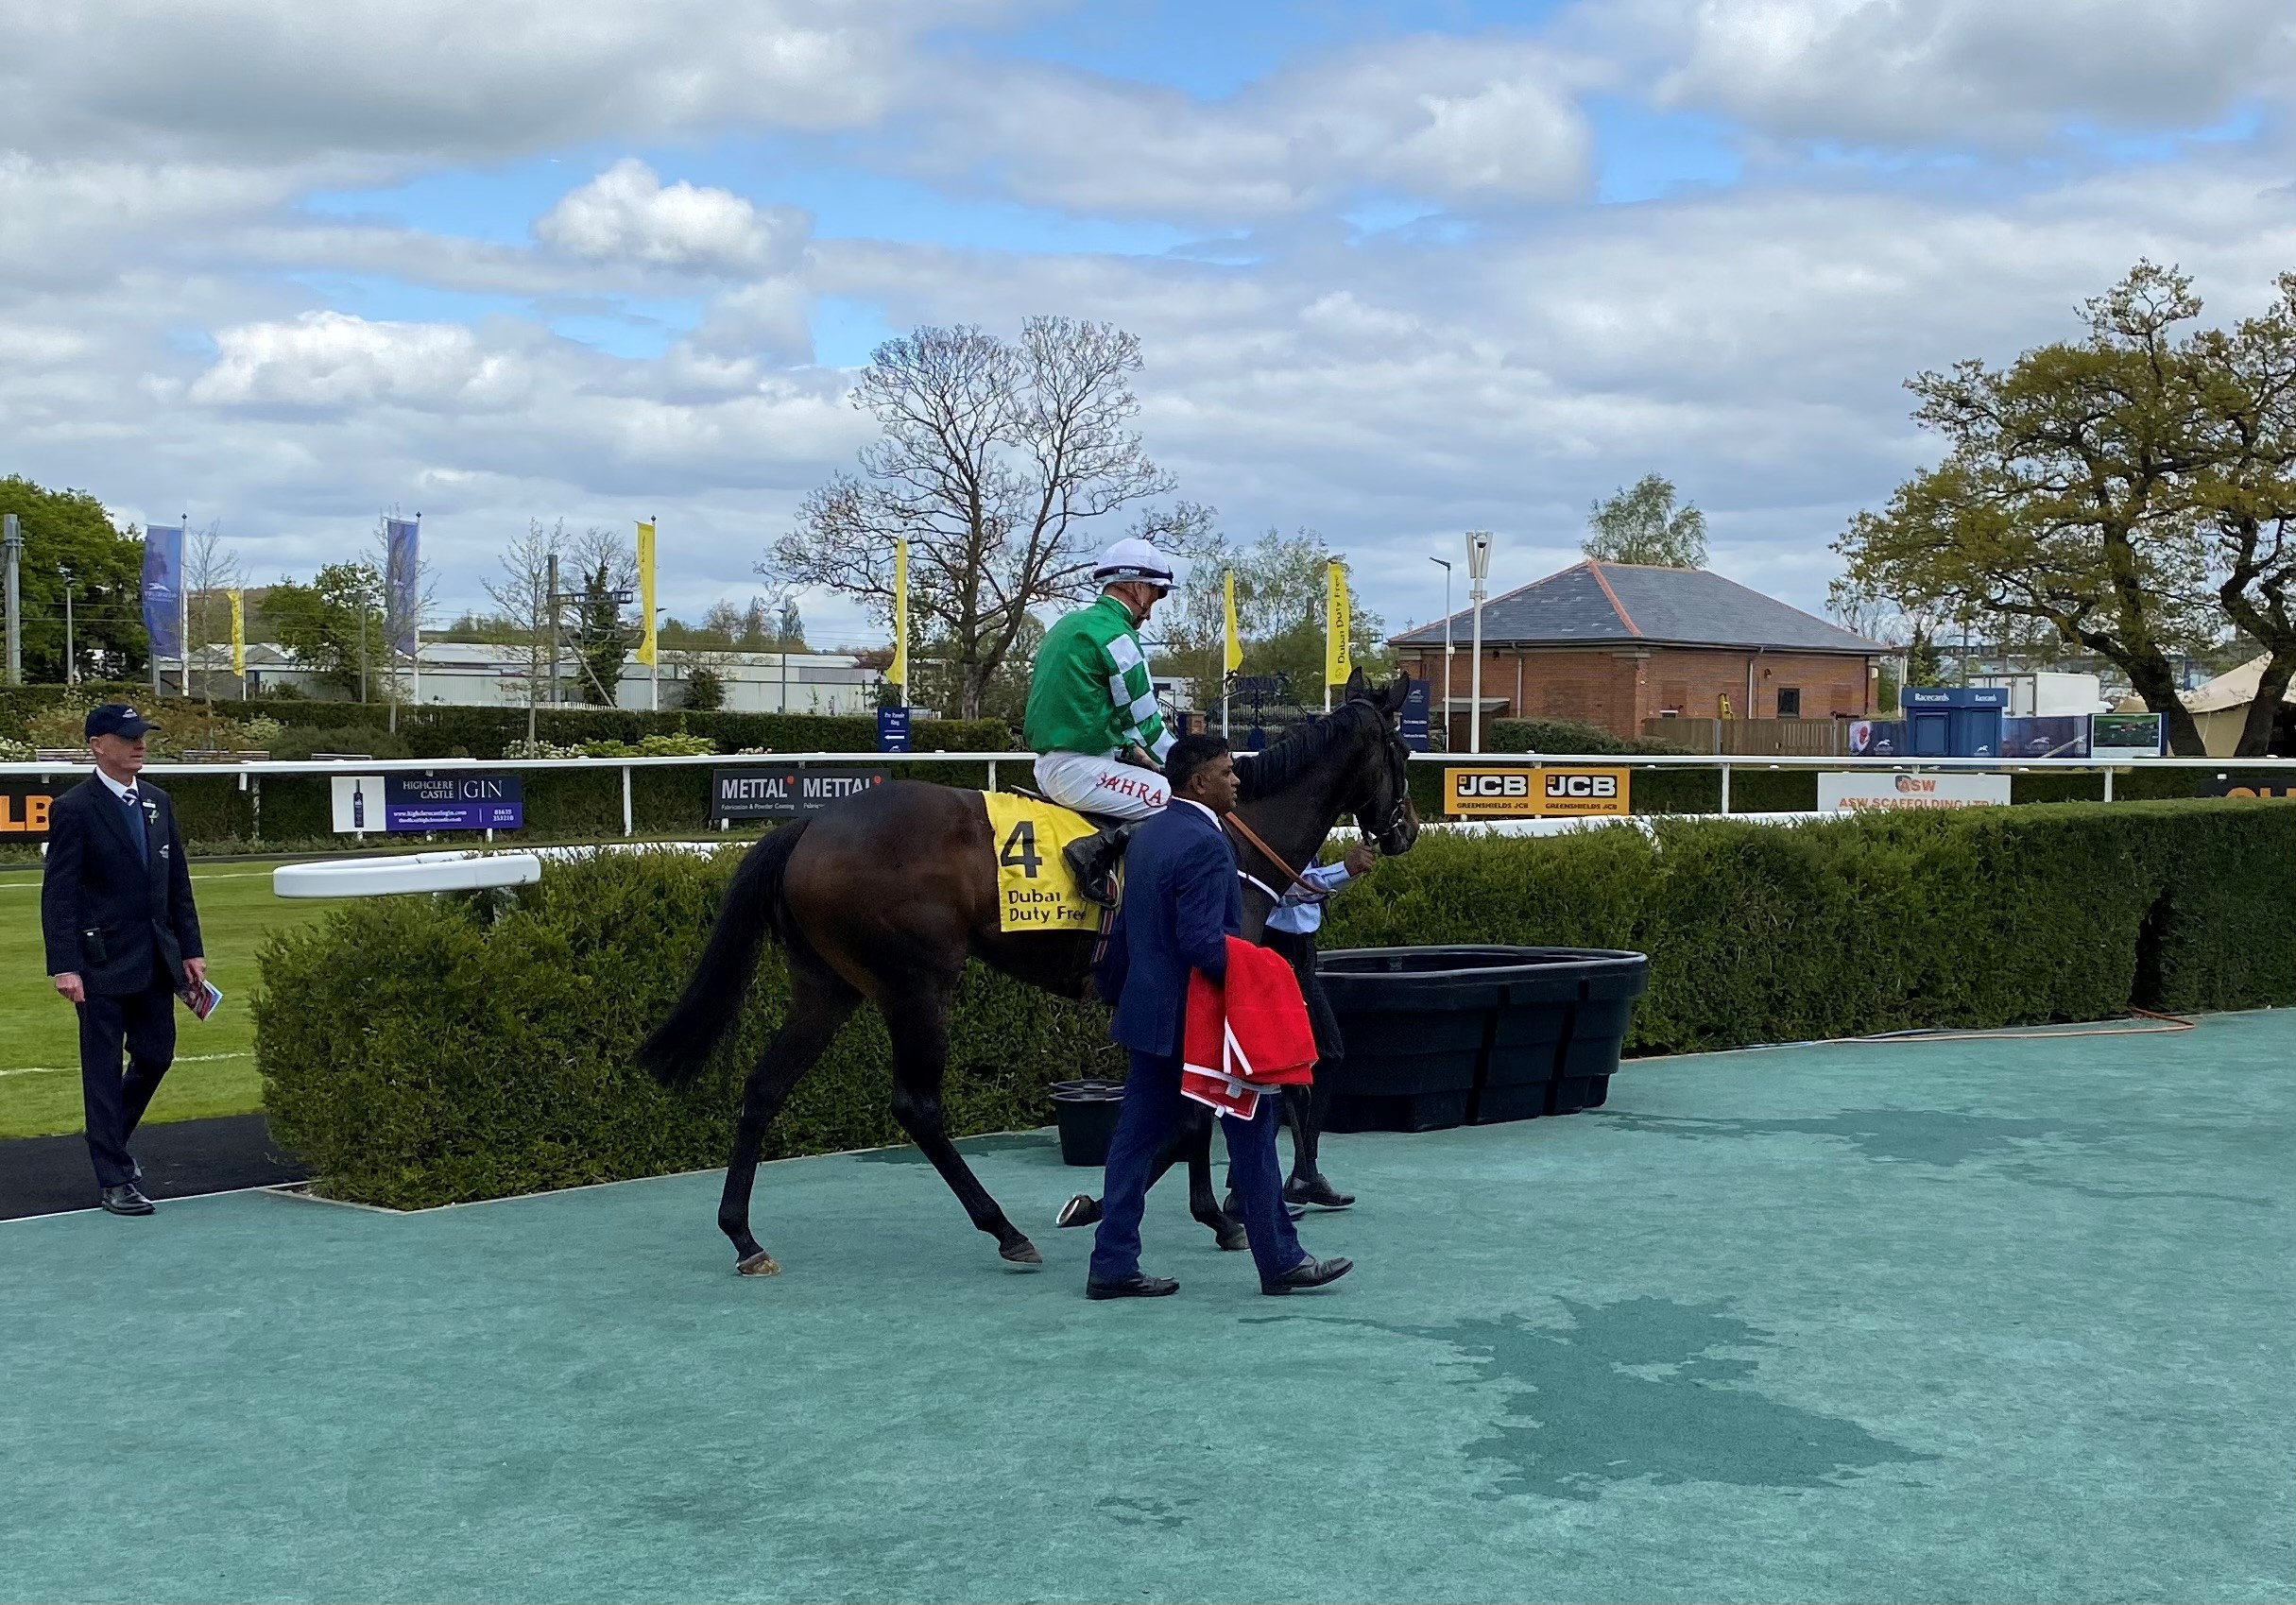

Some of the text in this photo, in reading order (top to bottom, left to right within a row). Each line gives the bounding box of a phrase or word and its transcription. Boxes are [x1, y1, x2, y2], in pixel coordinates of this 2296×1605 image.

[1335, 602, 1345, 628] Duty
[1337, 630, 1346, 664] Dubai
[1914, 692, 1950, 702] Racecards
[403, 780, 454, 790] HIGHCLERE
[463, 779, 503, 798] GIN
[721, 778, 788, 799] METTAL
[1458, 776, 1527, 795] JCB
[1547, 776, 1616, 796] JCB
[1899, 778, 1936, 793] ASW
[420, 790, 454, 799] CASTLE
[1545, 802, 1601, 811] GREENSHIELDS
[1839, 797, 1868, 809] ASW
[1872, 797, 1962, 810] SCAFFOLDING
[1000, 820, 1043, 879] 4
[1007, 888, 1061, 904] Dubai
[1008, 907, 1051, 923] Duty
